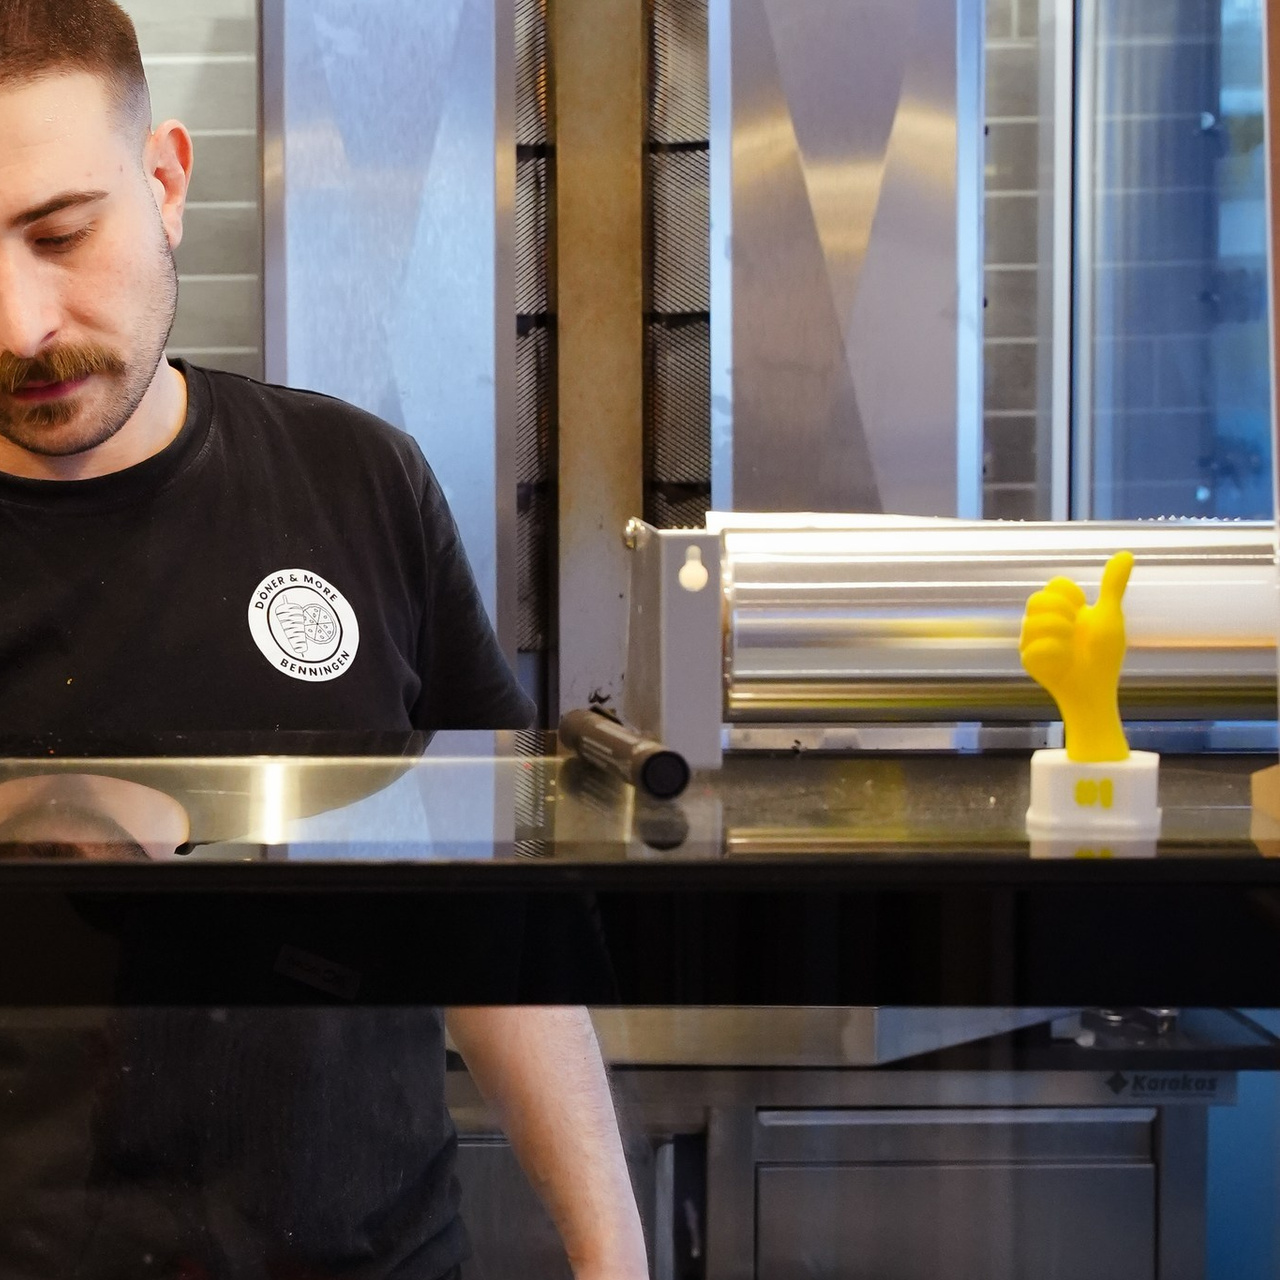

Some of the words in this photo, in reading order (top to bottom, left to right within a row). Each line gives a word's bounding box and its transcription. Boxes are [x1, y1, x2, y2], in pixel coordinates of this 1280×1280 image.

[254, 576, 285, 610] DÖNER
[289, 574, 298, 582] &
[303, 574, 338, 602] MORE
[280, 650, 350, 676] BENNINGEN
[1132, 1074, 1219, 1091] Karakas
